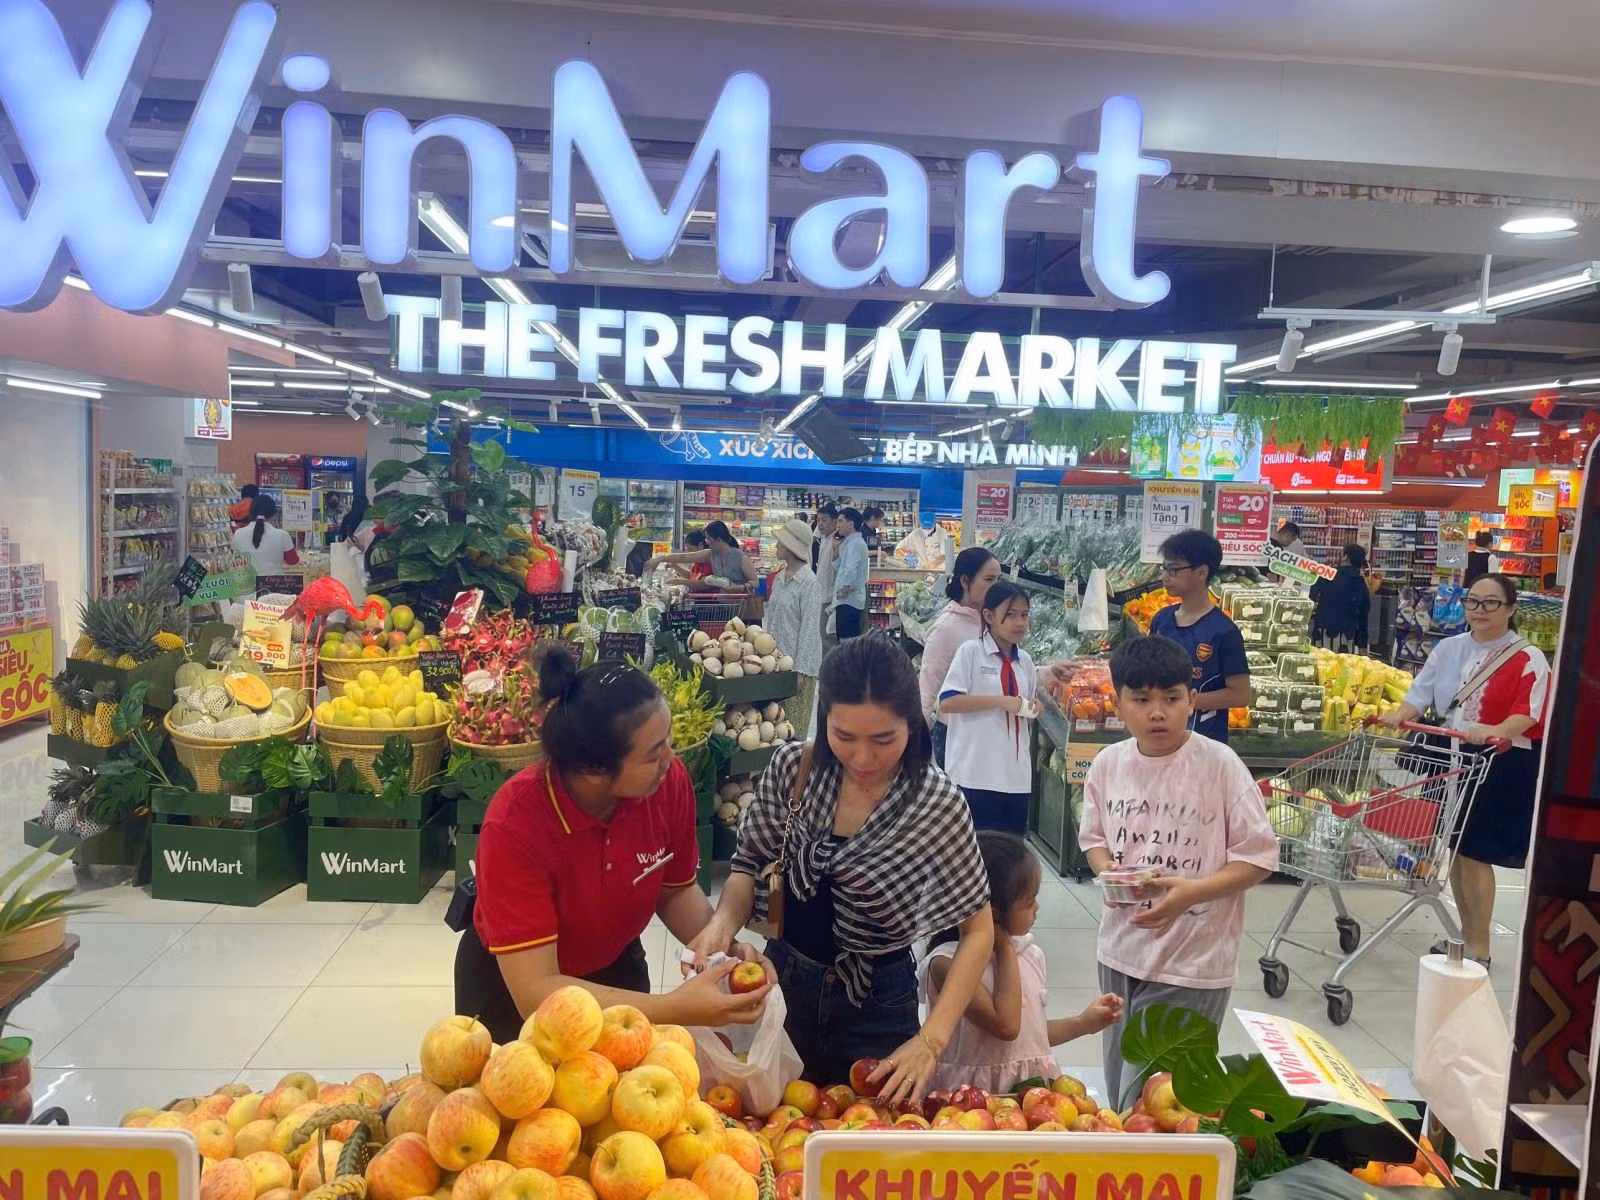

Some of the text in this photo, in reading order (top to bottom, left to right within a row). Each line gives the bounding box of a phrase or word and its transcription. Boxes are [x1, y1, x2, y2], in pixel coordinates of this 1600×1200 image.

[0, 0, 1170, 311] WinMart
[383, 293, 1237, 414] THE FRESH MARKET
[771, 438, 818, 460] XÍC
[884, 431, 933, 464] BẾP
[324, 459, 348, 467] pepsi
[569, 485, 585, 497] 15
[1152, 511, 1178, 525] Tặng
[1153, 503, 1171, 512] Mua
[1180, 505, 1190, 524] 1
[1297, 559, 1335, 580] NGON
[250, 601, 286, 615] WinMar
[163, 849, 244, 875] WinMart
[320, 851, 406, 875] WinMart
[834, 1158, 1077, 1200] KHUYẾN
